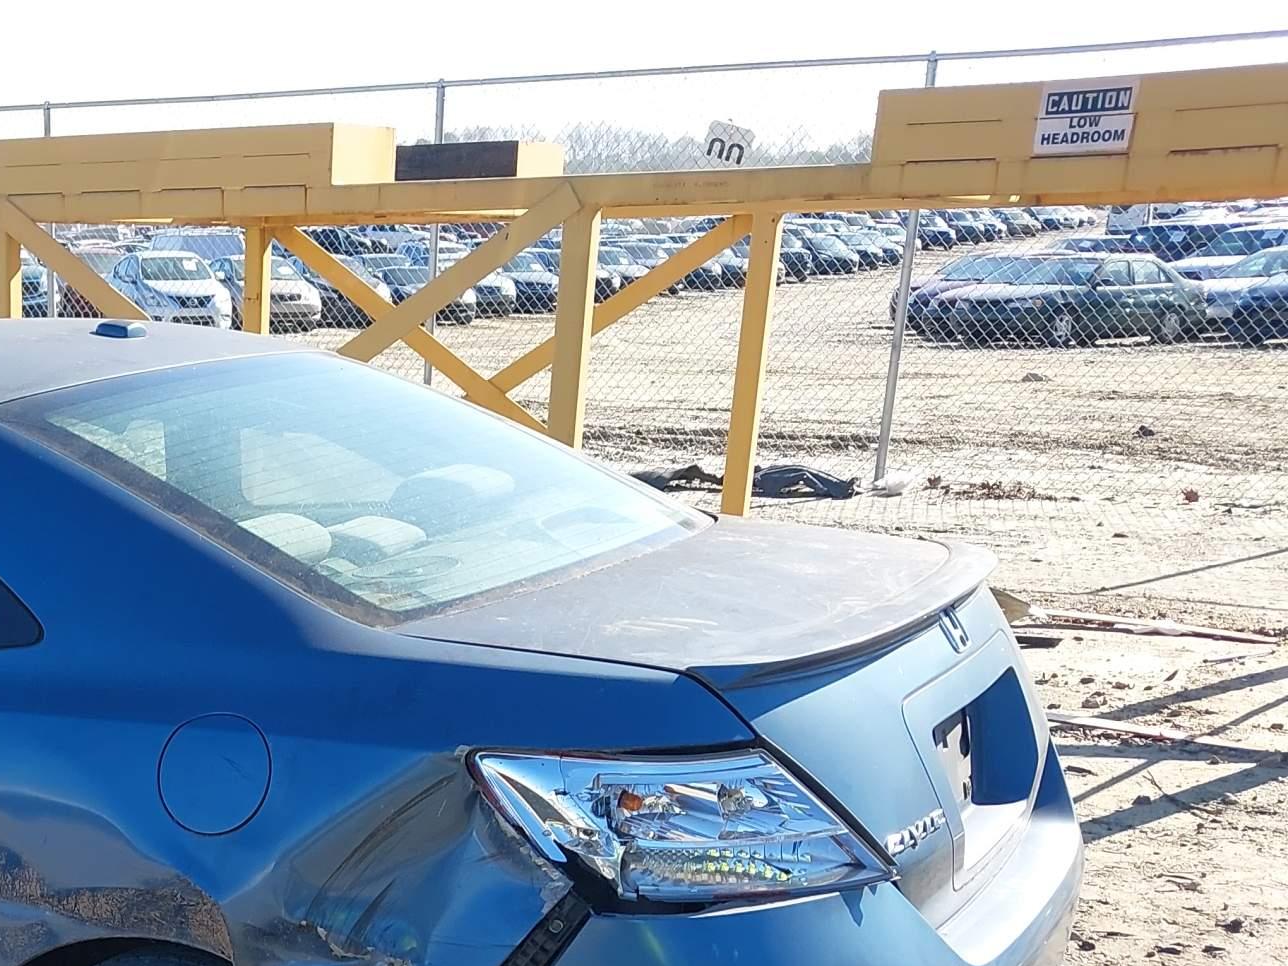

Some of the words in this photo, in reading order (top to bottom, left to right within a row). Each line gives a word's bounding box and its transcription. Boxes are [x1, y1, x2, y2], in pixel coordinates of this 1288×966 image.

[1047, 90, 1131, 112] CAUTION
[1068, 115, 1102, 129] LOW
[1040, 128, 1126, 146] HEADROOM
